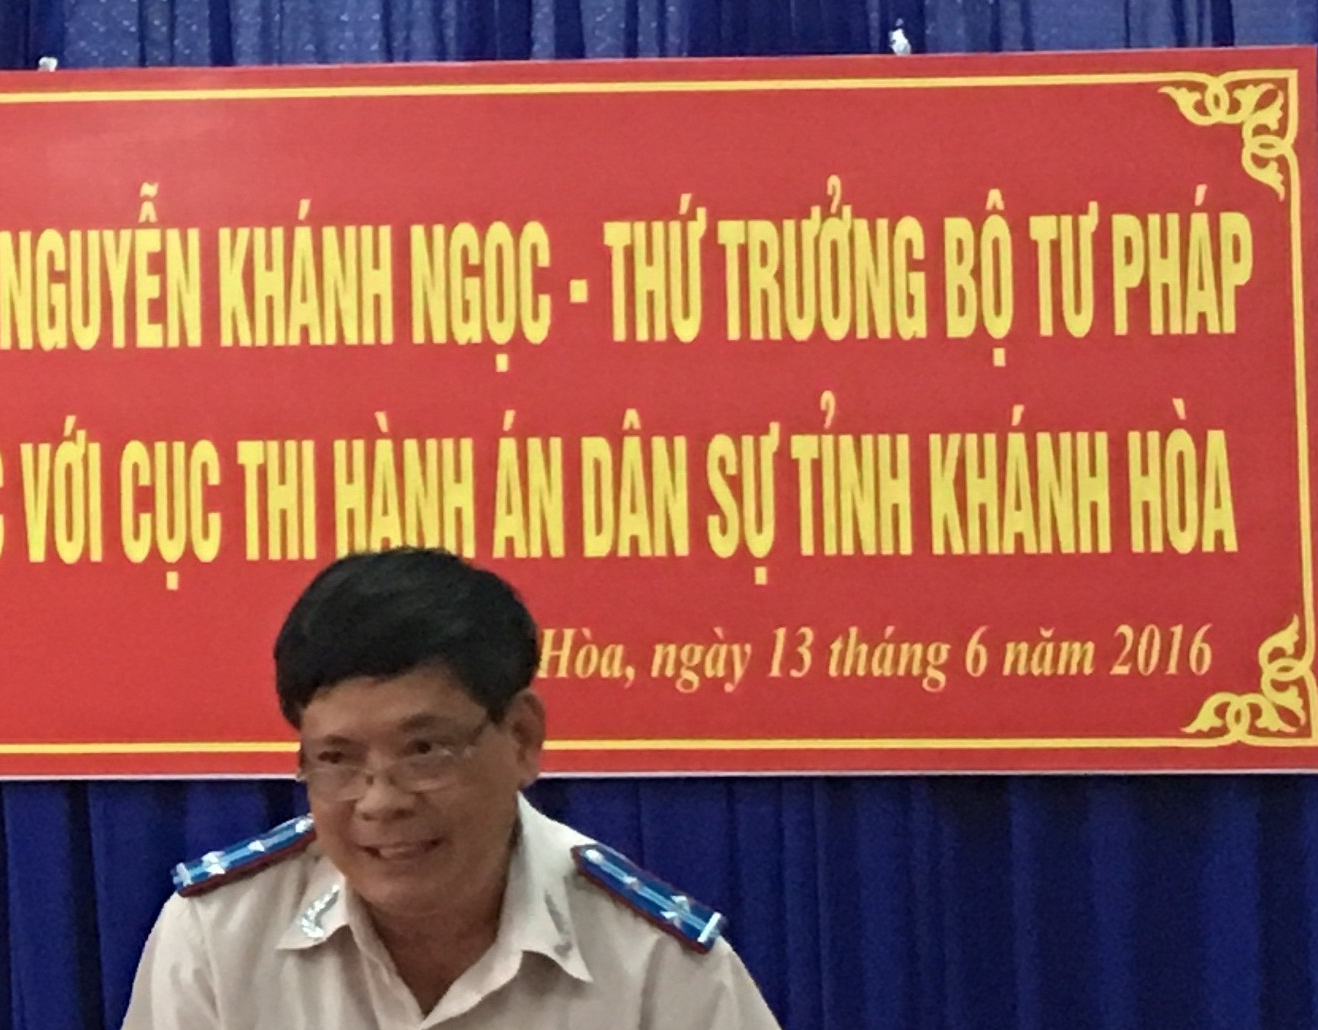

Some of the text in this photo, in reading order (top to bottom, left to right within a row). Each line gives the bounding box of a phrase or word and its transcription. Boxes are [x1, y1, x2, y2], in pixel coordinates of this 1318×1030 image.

[218, 199, 394, 347] KHÁNH
[410, 221, 551, 372] NGỌC
[570, 279, 588, 303] -
[604, 193, 707, 342] THỨ
[718, 175, 927, 341] TRƯỞNG
[944, 189, 1013, 366] BỘ
[1029, 201, 1098, 337] TƯ
[1112, 184, 1253, 335] PHÁP
[20, 415, 102, 564] VỚI
[120, 439, 221, 590] CỤC
[237, 440, 316, 560] THI
[334, 412, 475, 559] HÀNH
[493, 410, 564, 558] ÁN
[581, 409, 689, 557] DÂN
[707, 422, 780, 584] SỰ
[791, 391, 912, 555] TỈNH
[929, 405, 1111, 554] KHÁNH
[1128, 399, 1237, 553] HÒA
[537, 623, 1213, 693] Hòa, ngày 13 tháng 6 năm 2016
